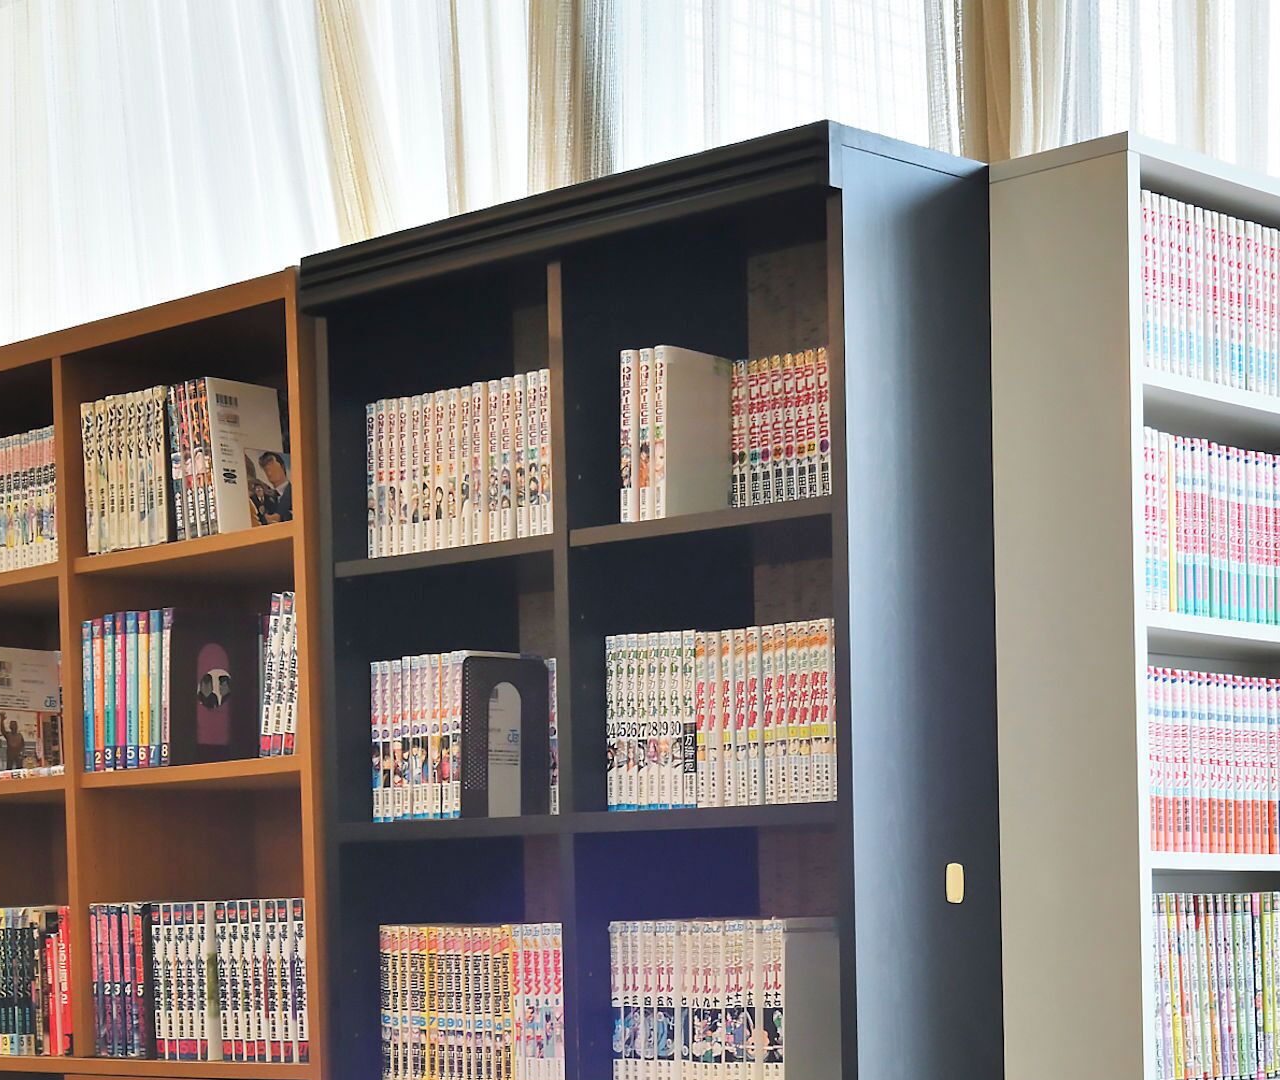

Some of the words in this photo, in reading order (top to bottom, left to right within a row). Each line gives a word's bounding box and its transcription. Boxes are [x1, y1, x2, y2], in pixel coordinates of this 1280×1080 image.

[105, 748, 111, 760] 3
[116, 747, 121, 759] 4
[127, 747, 134, 759] 5
[139, 747, 146, 760] 6
[150, 746, 155, 758] 7
[162, 745, 168, 757] 8
[95, 752, 101, 763] 2
